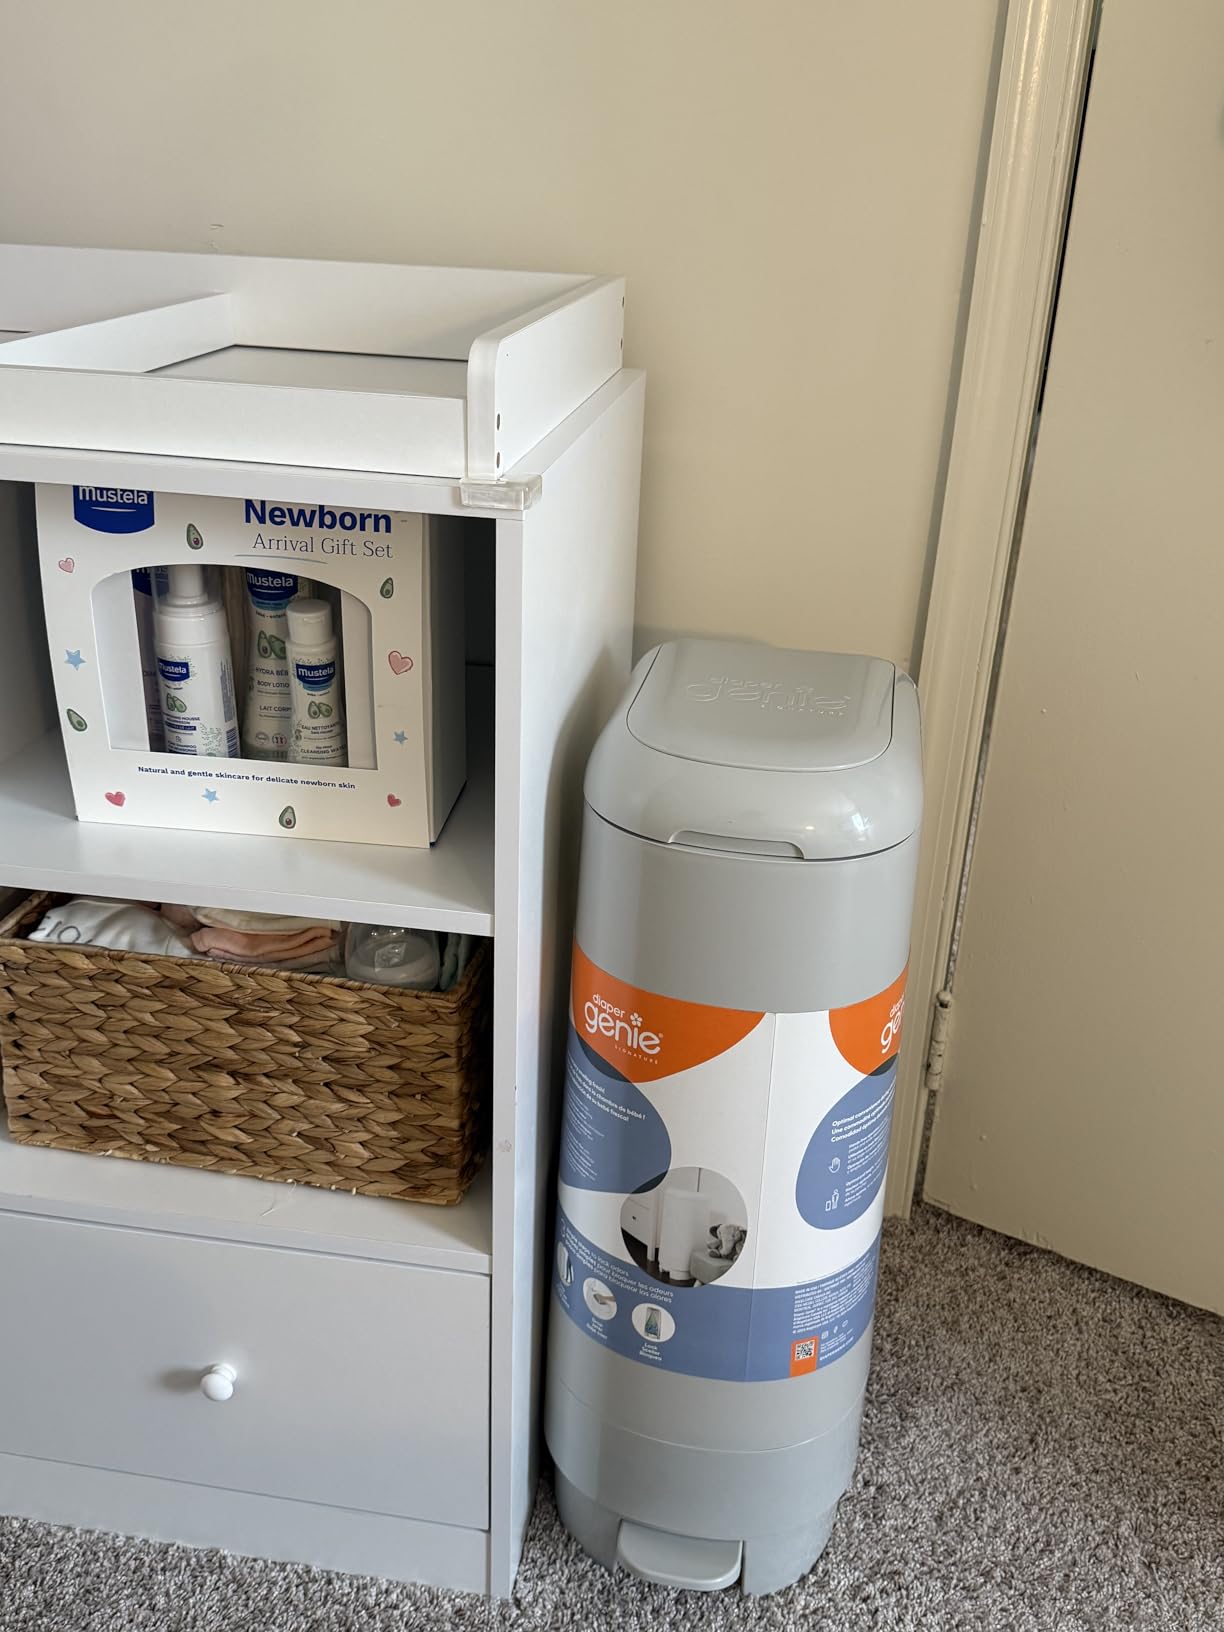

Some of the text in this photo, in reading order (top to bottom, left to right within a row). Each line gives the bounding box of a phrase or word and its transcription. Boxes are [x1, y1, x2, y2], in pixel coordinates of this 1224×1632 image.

[79, 486, 148, 504] mustela
[244, 499, 392, 534] Newborn
[252, 533, 394, 559] Arrival Gift Set
[298, 666, 334, 678] mustela
[257, 680, 290, 688] BODY LOTIO
[138, 766, 169, 775] Natural
[187, 770, 213, 778] gentle
[215, 772, 250, 780] skincare
[251, 774, 264, 782] for
[266, 775, 299, 785] delicate
[300, 778, 337, 788] newborn
[338, 782, 356, 790] skin
[592, 993, 626, 1018] diaper
[584, 1001, 661, 1055] genie
[832, 1114, 855, 1127] Optimal
[610, 1264, 630, 1277] odors
[648, 1285, 675, 1298] odeurs
[649, 1292, 673, 1304] olores
